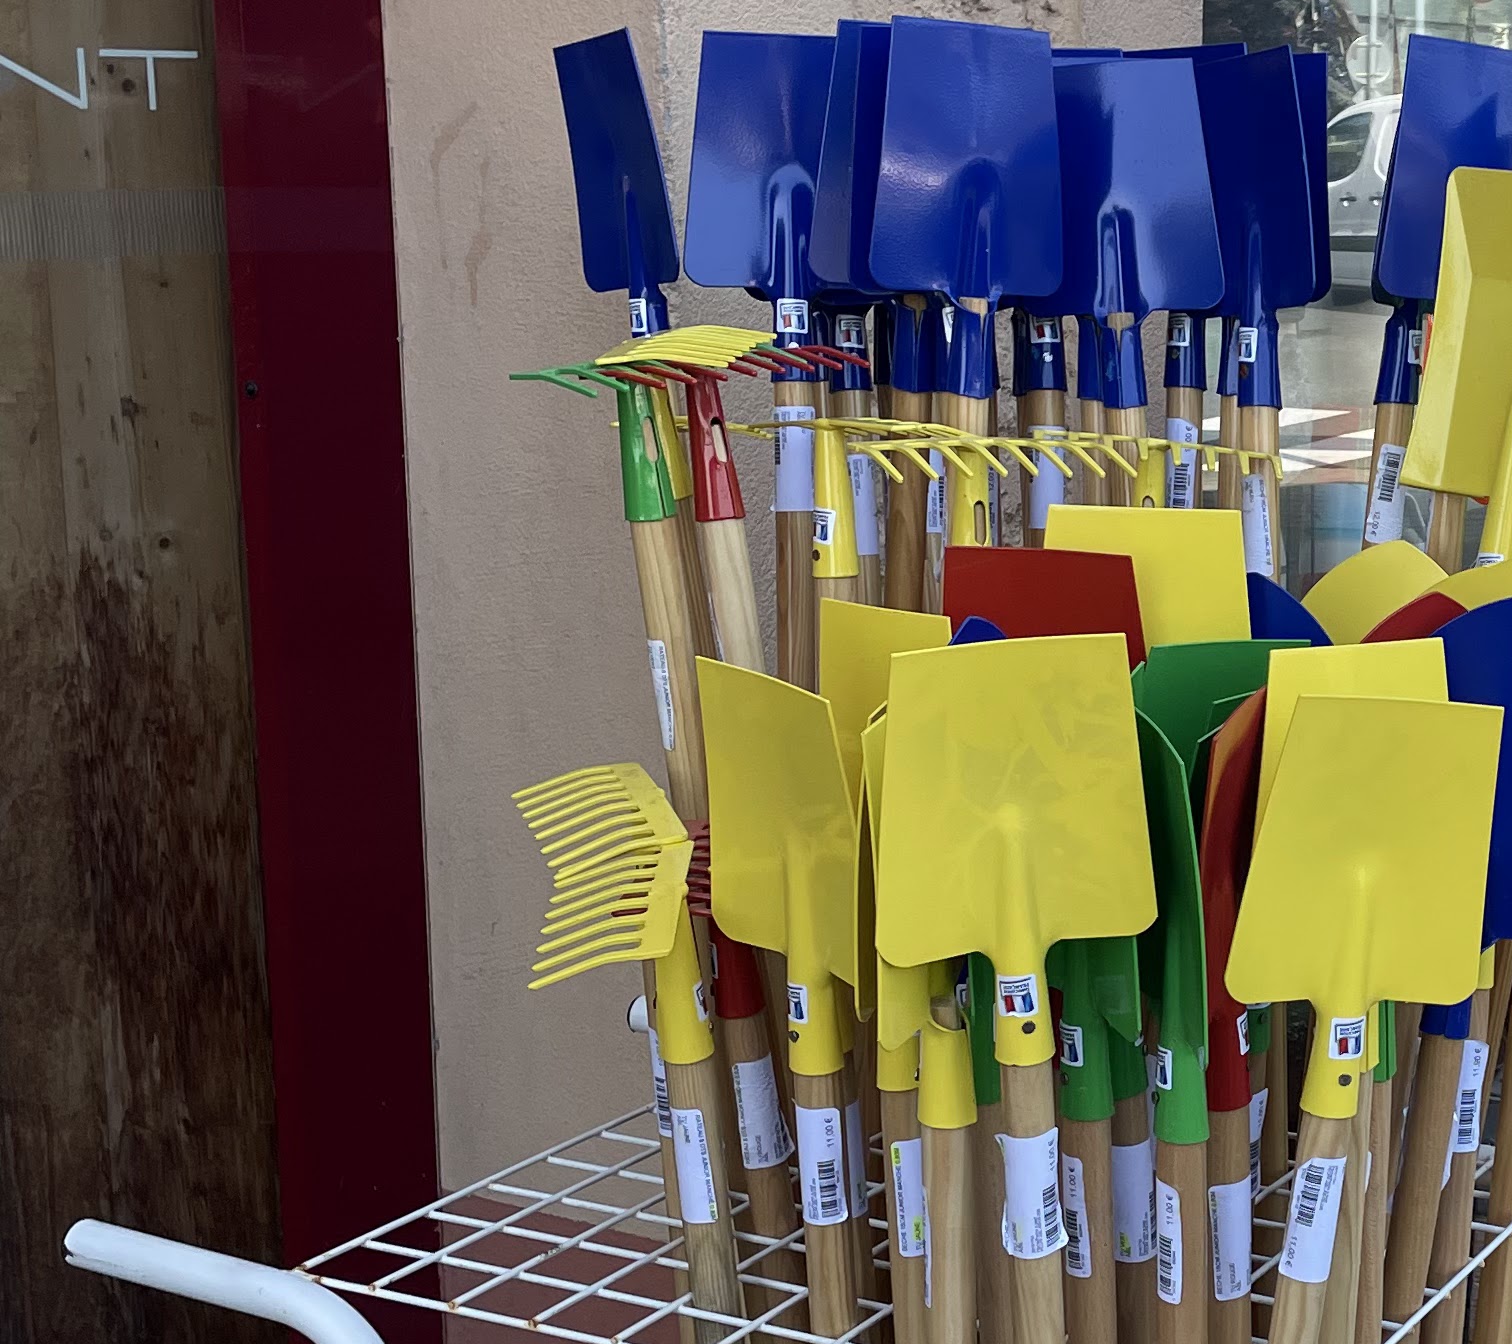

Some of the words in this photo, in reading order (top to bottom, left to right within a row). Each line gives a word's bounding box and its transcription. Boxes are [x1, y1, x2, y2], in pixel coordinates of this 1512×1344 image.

[695, 1115, 703, 1140] RATEAU
[702, 1156, 710, 1178] JUNIOR
[706, 1179, 714, 1204] MANCHE
[895, 1165, 903, 1191] MANCHE
